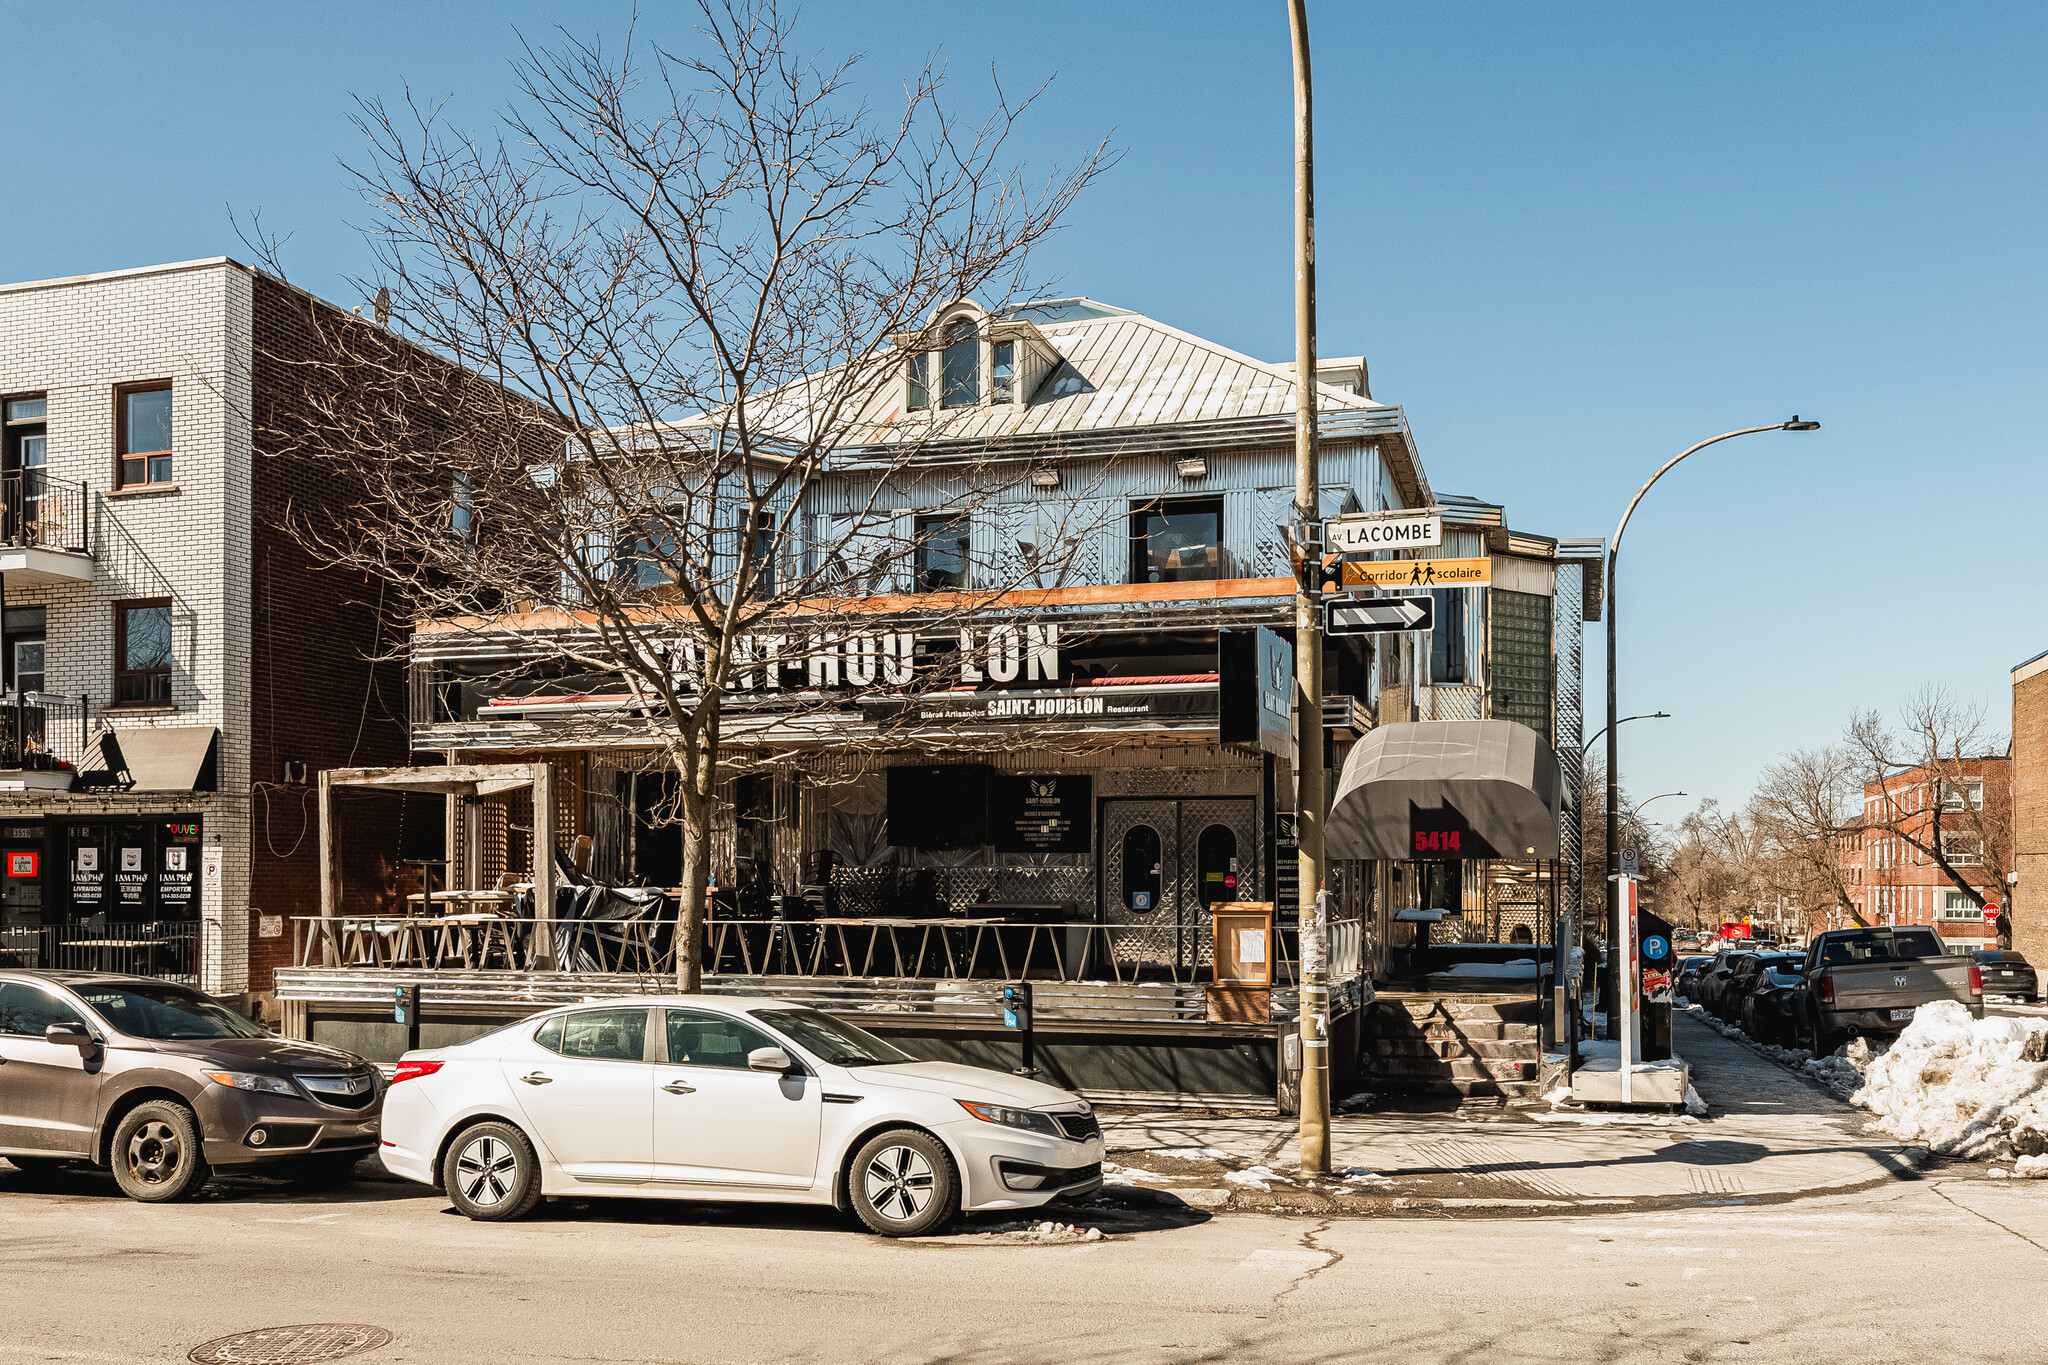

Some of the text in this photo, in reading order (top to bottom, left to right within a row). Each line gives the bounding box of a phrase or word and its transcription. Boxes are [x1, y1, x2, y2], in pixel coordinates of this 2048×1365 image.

[1347, 524, 1432, 544] LACOMBE
[1359, 567, 1482, 582] Corridor scolaire
[987, 697, 1104, 717] SAINT-HOUBLON
[1107, 704, 1149, 714] Restaurant
[1415, 831, 1461, 850] 5414
